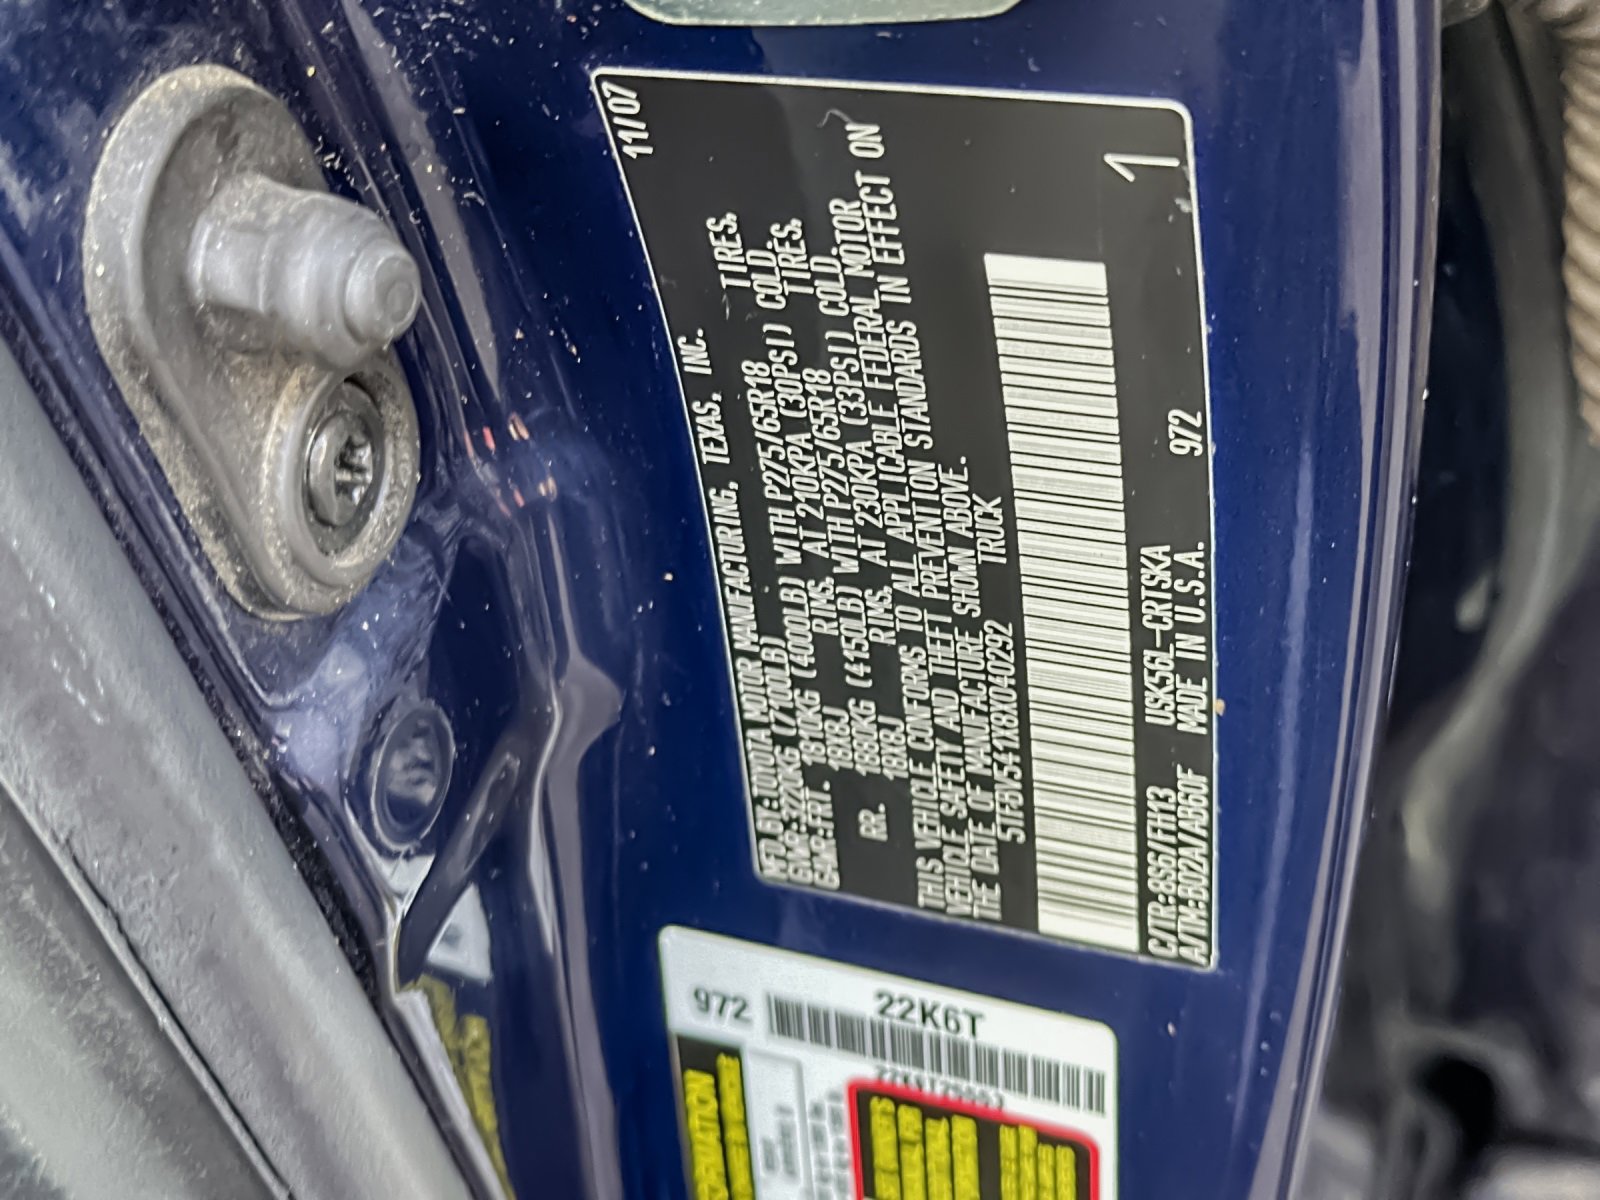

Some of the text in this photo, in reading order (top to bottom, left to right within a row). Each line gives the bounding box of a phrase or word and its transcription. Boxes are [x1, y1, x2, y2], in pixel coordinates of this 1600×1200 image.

[602, 80, 653, 159] 11/07
[747, 242, 786, 309] COLD.
[810, 247, 849, 316] COLD.
[677, 329, 712, 374] INC.
[764, 323, 807, 418] (30PSI)
[825, 331, 869, 425] (33PSI)
[692, 392, 730, 464] TEXAS,
[741, 360, 792, 501] P275/65R18
[803, 369, 851, 510] P275/65R18
[1167, 409, 1203, 457] 972
[783, 433, 822, 519] 210KPA
[844, 440, 883, 528] 230KPA
[768, 507, 802, 564] WITH
[800, 526, 829, 559] AT
[826, 515, 860, 573] WITH
[829, 198, 944, 908] THIS VEHICLE CONFORMS TO ALL APPLICABLE FEDERAL MOTOR
[846, 124, 973, 917] VEHICLE SAFETY AND THEFT PREVENTION STANDARDS IN EFFECT ON
[858, 535, 888, 566] AT
[972, 493, 1008, 564] TRUCK
[708, 481, 759, 652] MANUFACTURING,
[1174, 542, 1206, 623] U.S.A.
[779, 576, 817, 679] (4000LB)
[837, 585, 872, 687] (4150LB)
[1174, 633, 1206, 660] IN
[738, 659, 768, 722] MOTOR
[761, 636, 797, 736] (7100LB)
[938, 455, 1002, 920] THE DATE OF MANUFACTURE SHOWN ABOVE.
[1176, 674, 1207, 735] MADE
[793, 690, 827, 767] 1810KG
[823, 706, 853, 771] 18X8J
[848, 698, 881, 777] 1880KG
[878, 714, 909, 781] 18X8J
[859, 802, 888, 842] RR.
[693, 987, 752, 1021] 972
[874, 989, 985, 1039] 22K6T
